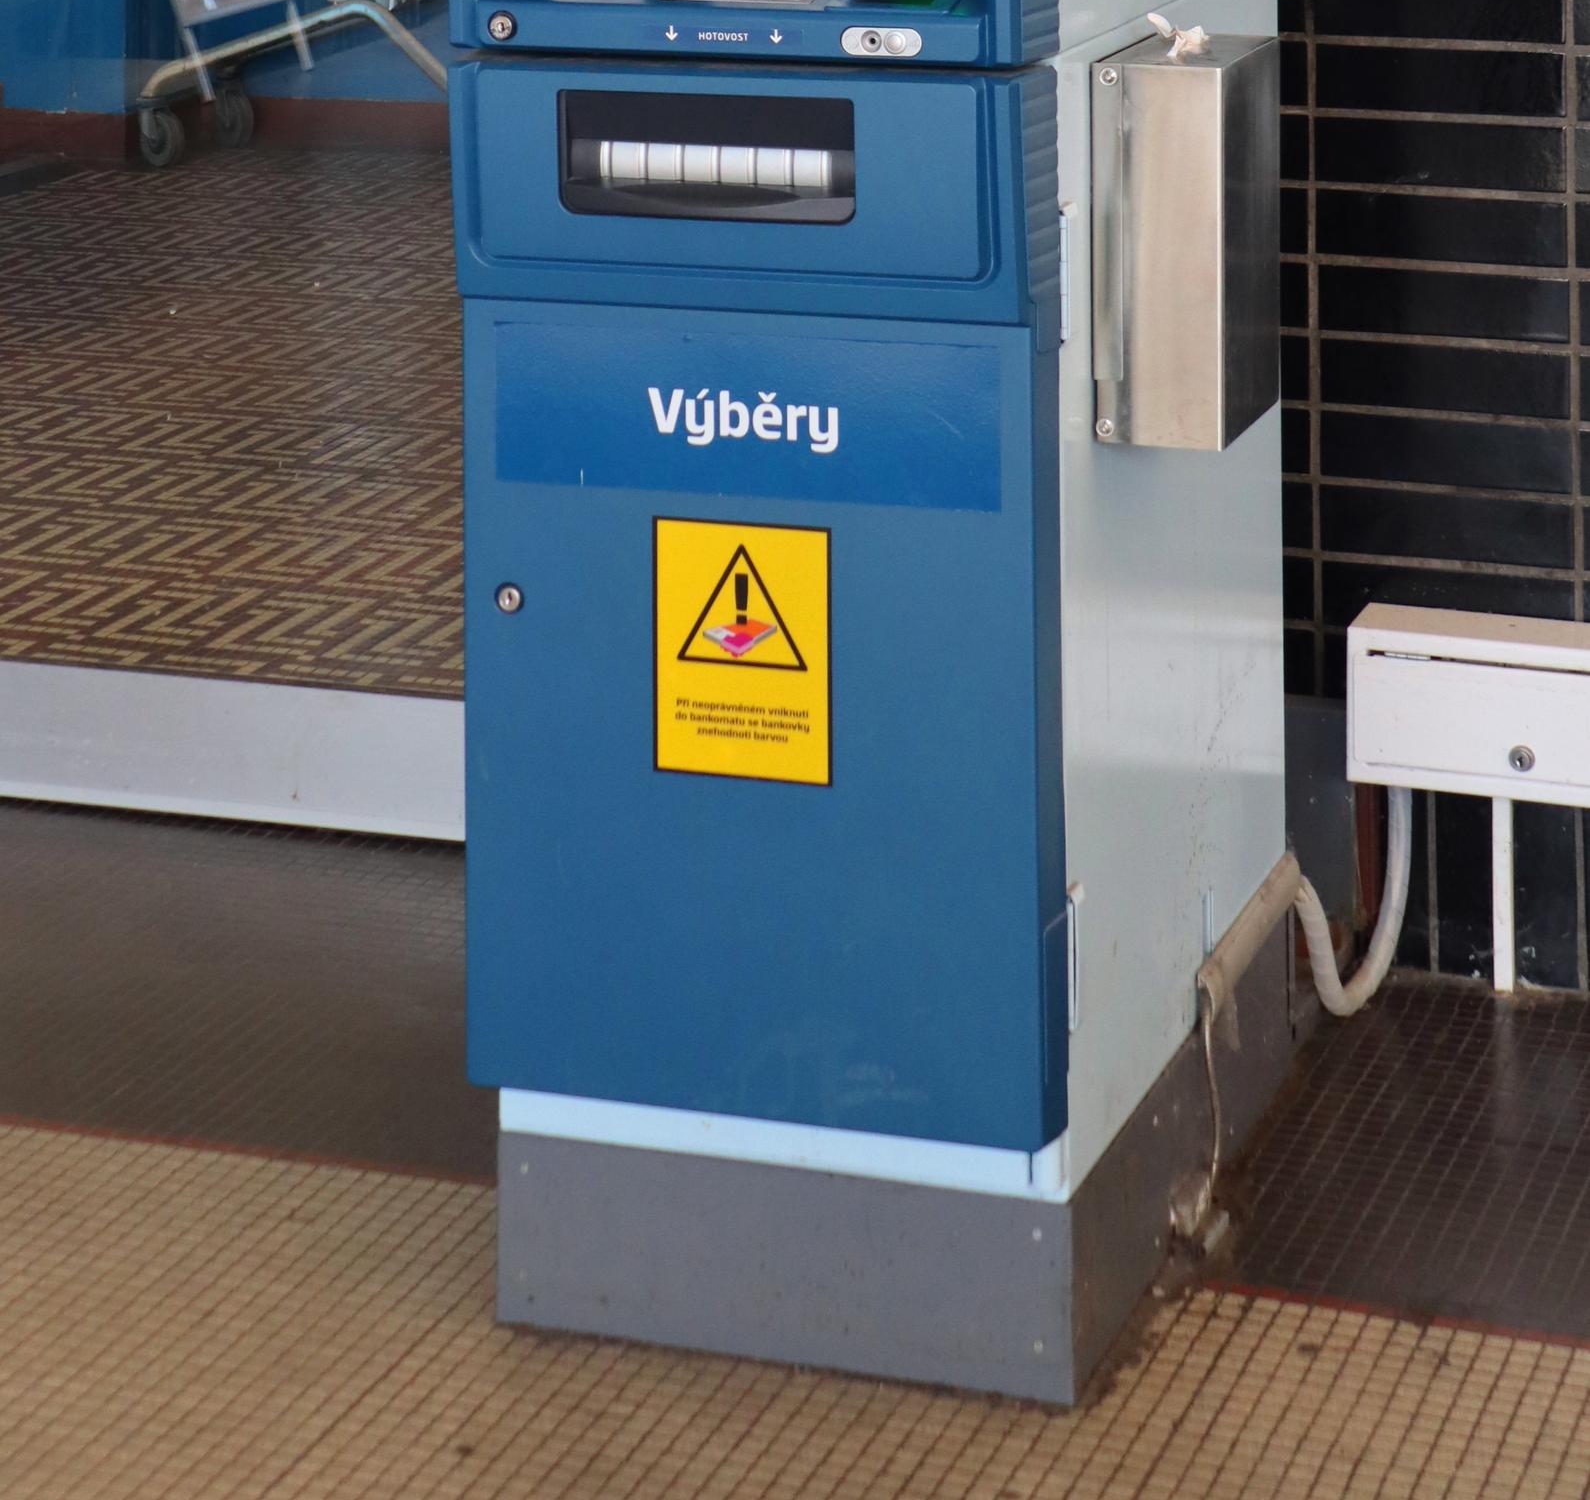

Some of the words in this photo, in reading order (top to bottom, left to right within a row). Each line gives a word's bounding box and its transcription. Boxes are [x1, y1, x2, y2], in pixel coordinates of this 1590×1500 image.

[698, 30, 748, 42] HOTOVOST
[647, 386, 839, 454] Výběry
[676, 697, 689, 707] Při
[692, 700, 765, 716] neoprávněném
[768, 705, 809, 719] vniknutí
[675, 711, 687, 720] do
[690, 713, 745, 727] bankomatu
[748, 719, 761, 727] se
[761, 718, 810, 734] bankovky
[697, 727, 751, 741] znehodnotí
[753, 732, 788, 744] barvou
